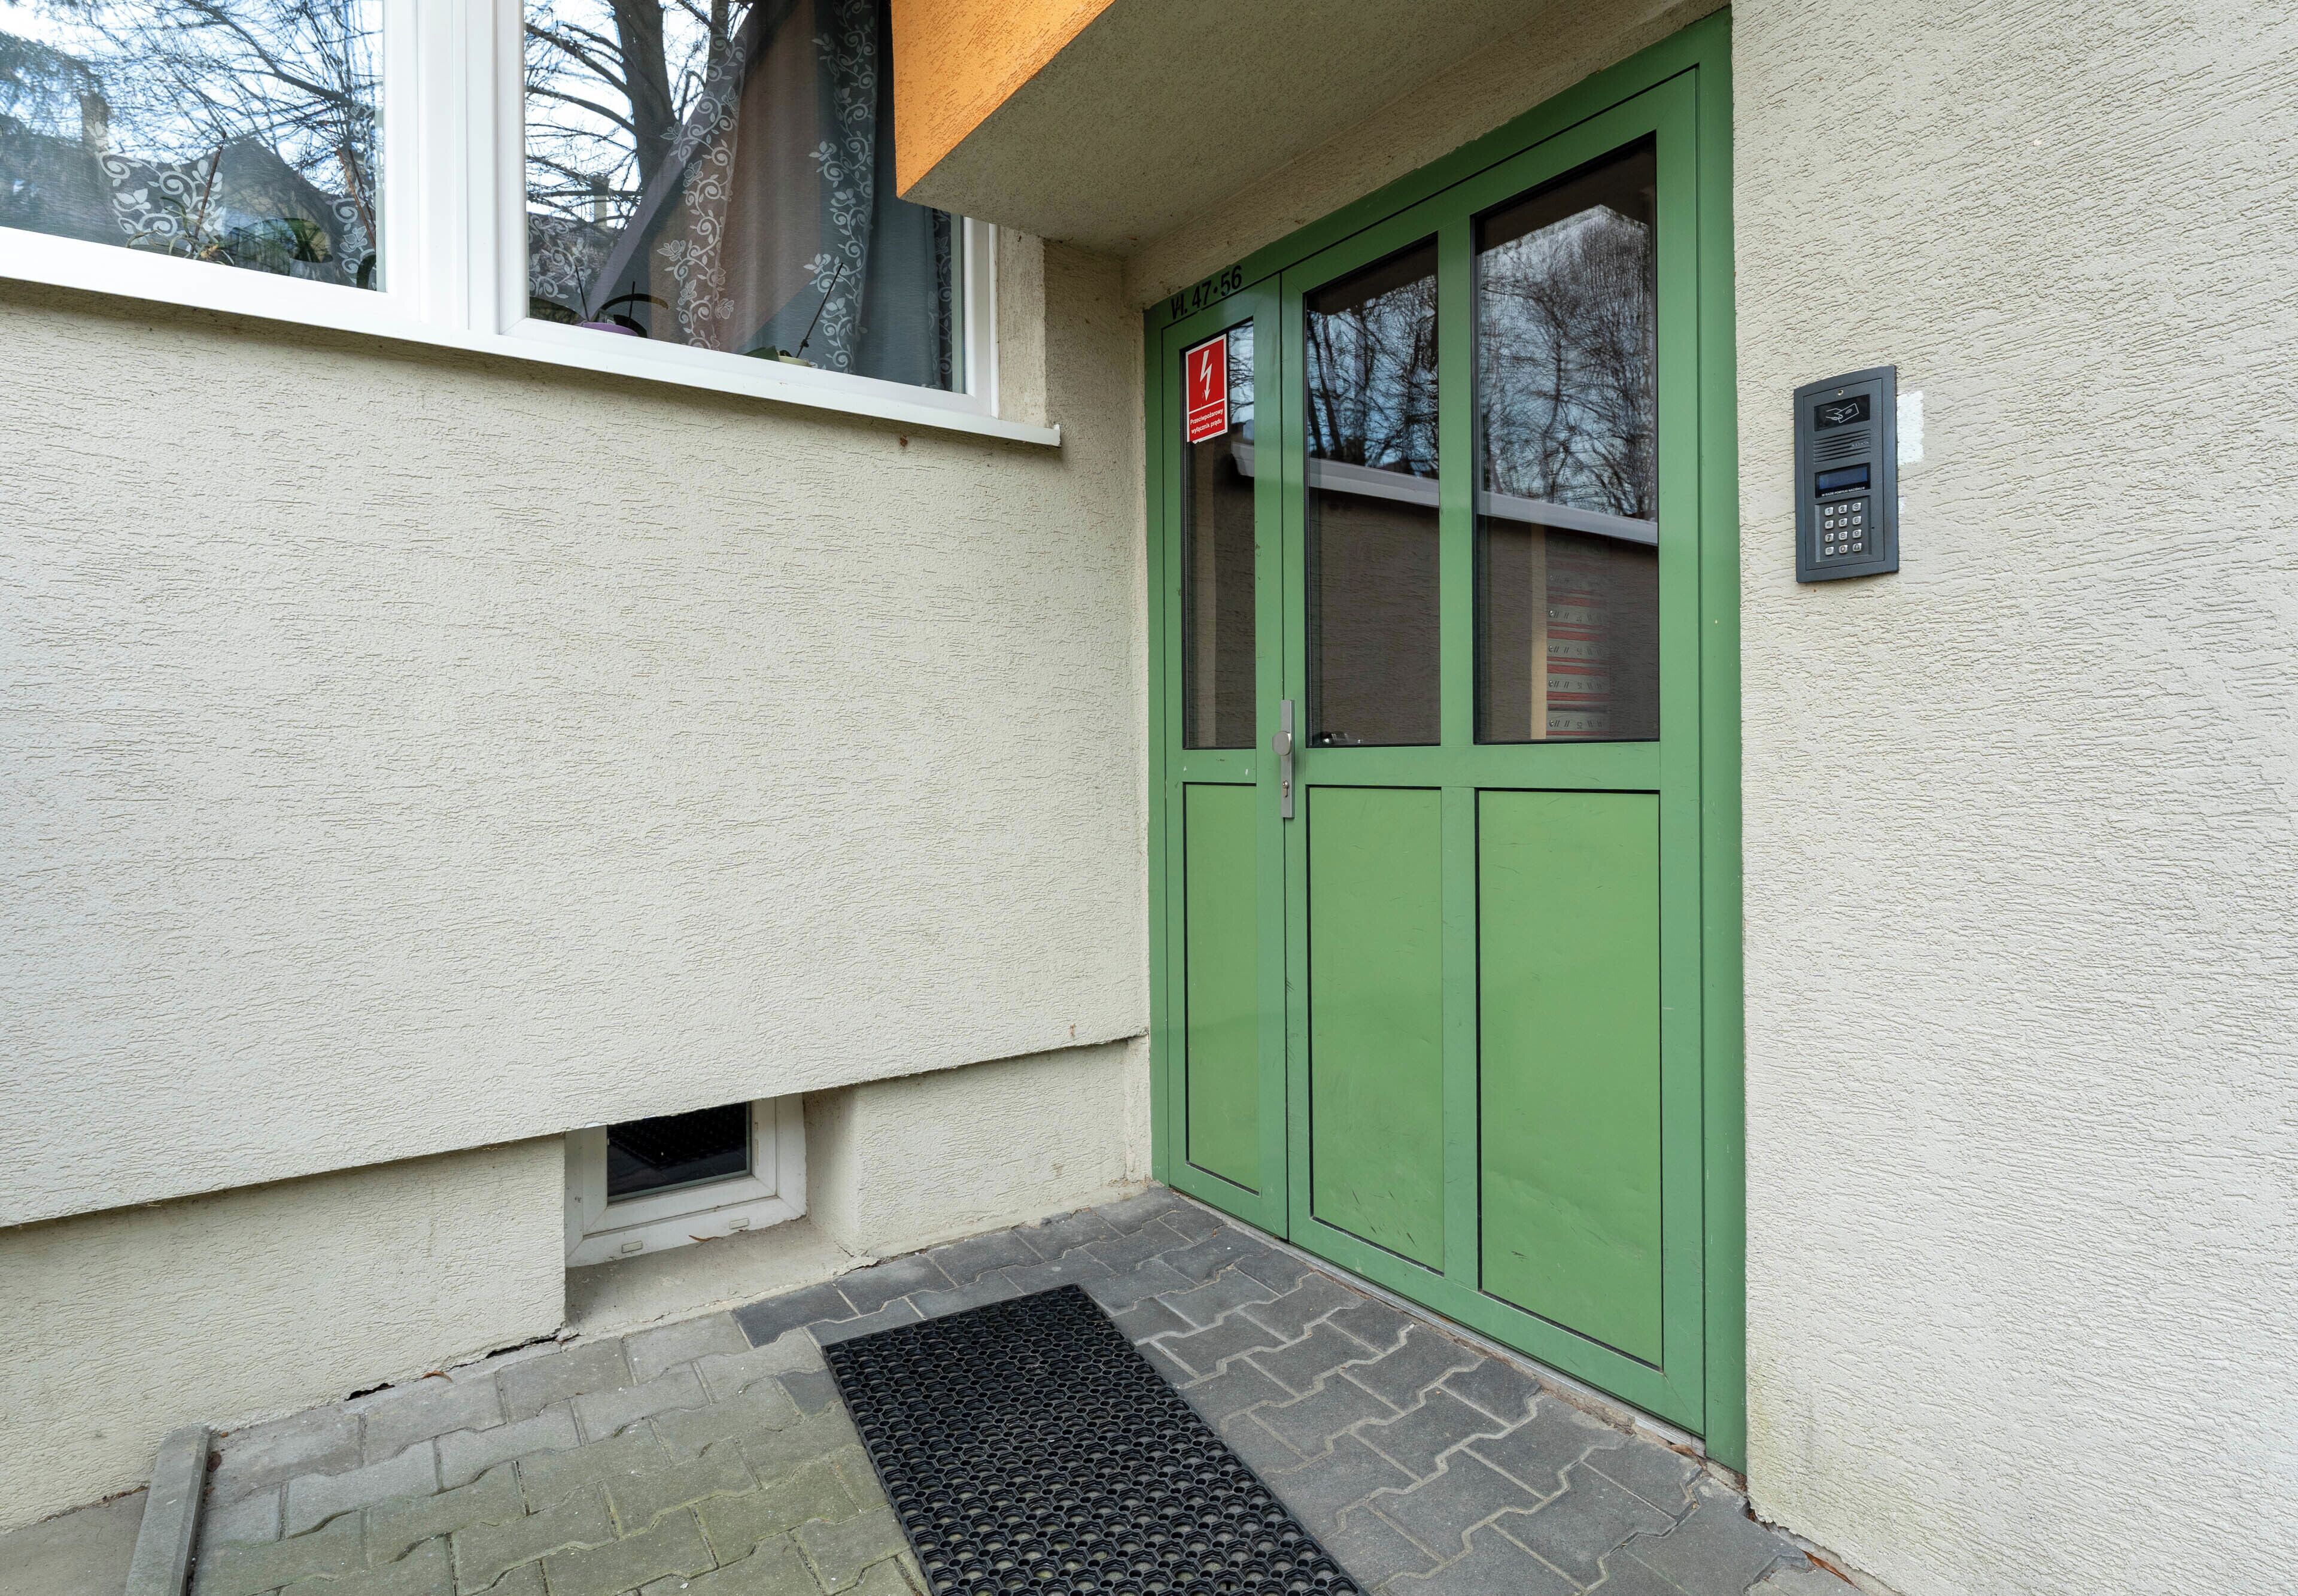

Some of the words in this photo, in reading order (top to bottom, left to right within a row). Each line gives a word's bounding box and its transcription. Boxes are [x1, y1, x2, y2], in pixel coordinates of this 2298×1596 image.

[1190, 408, 1223, 425] Przeciwpożarowy
[1191, 422, 1210, 434] wyłącznik
[1210, 418, 1222, 428] prądu
